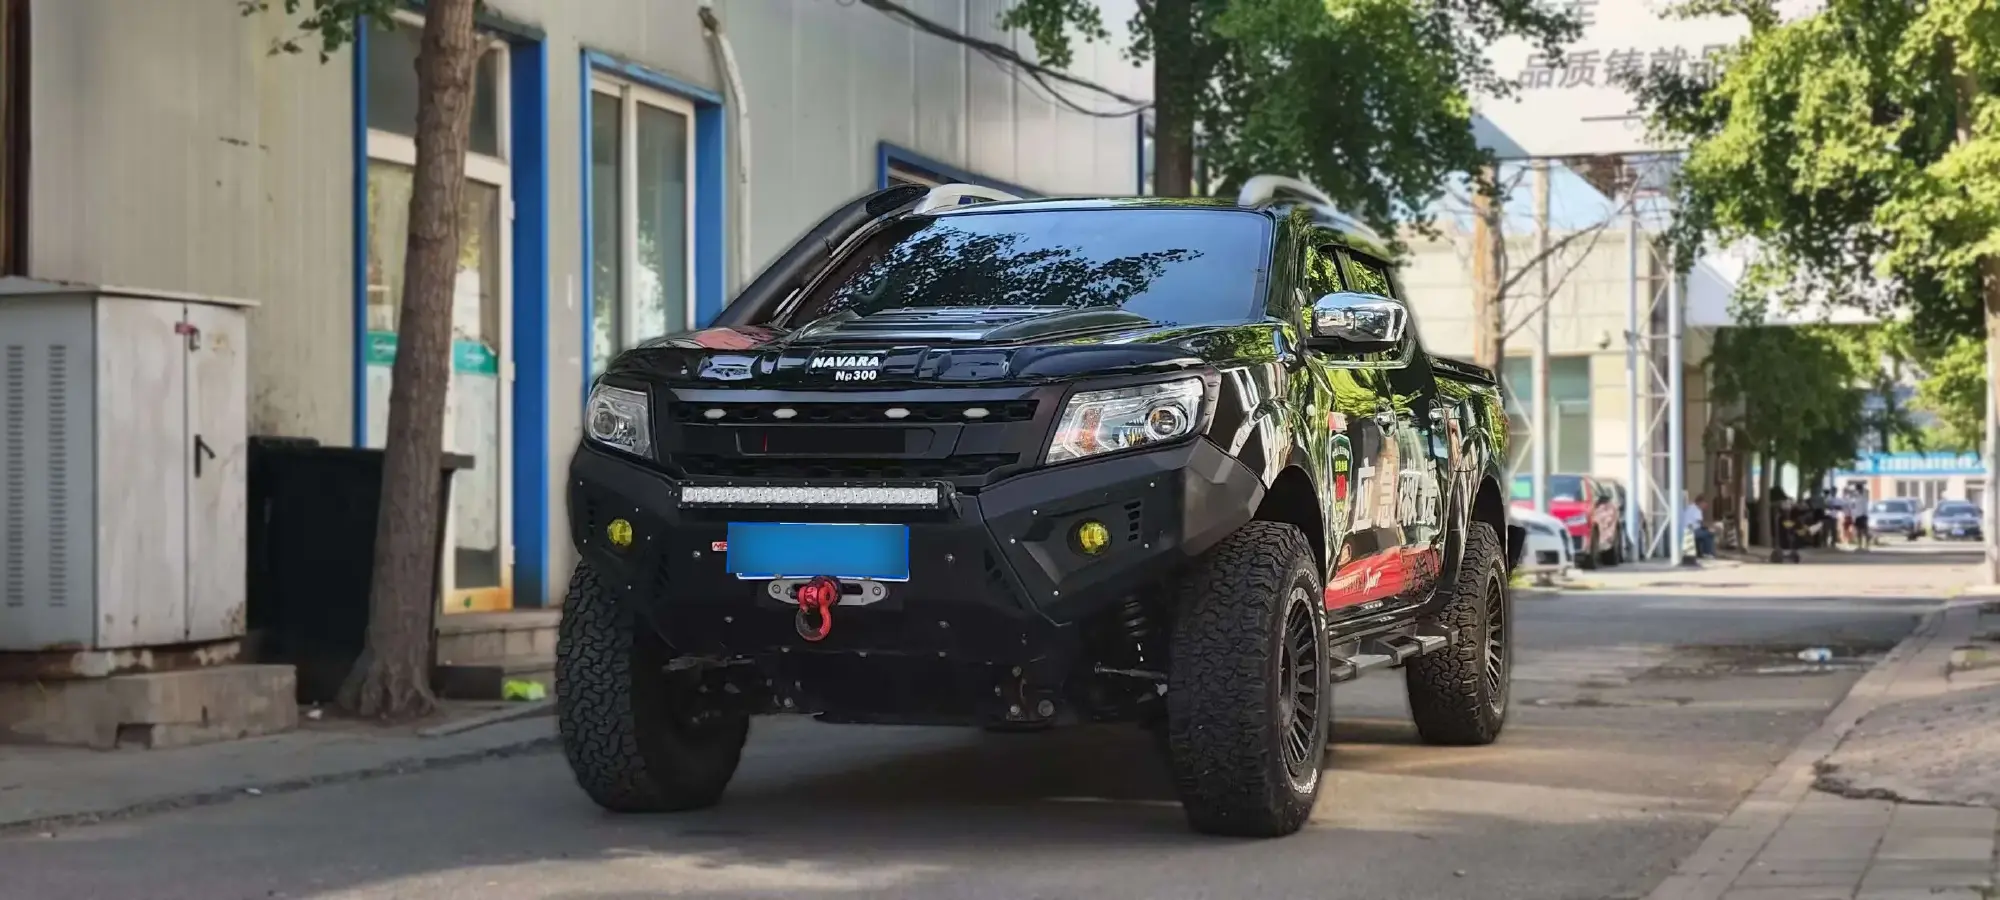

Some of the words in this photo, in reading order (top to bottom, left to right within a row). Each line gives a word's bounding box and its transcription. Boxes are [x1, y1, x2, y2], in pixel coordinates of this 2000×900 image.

[1518, 44, 1736, 90] 品质铸就品
[811, 356, 879, 368] NAVARA
[835, 370, 877, 382] Np300
